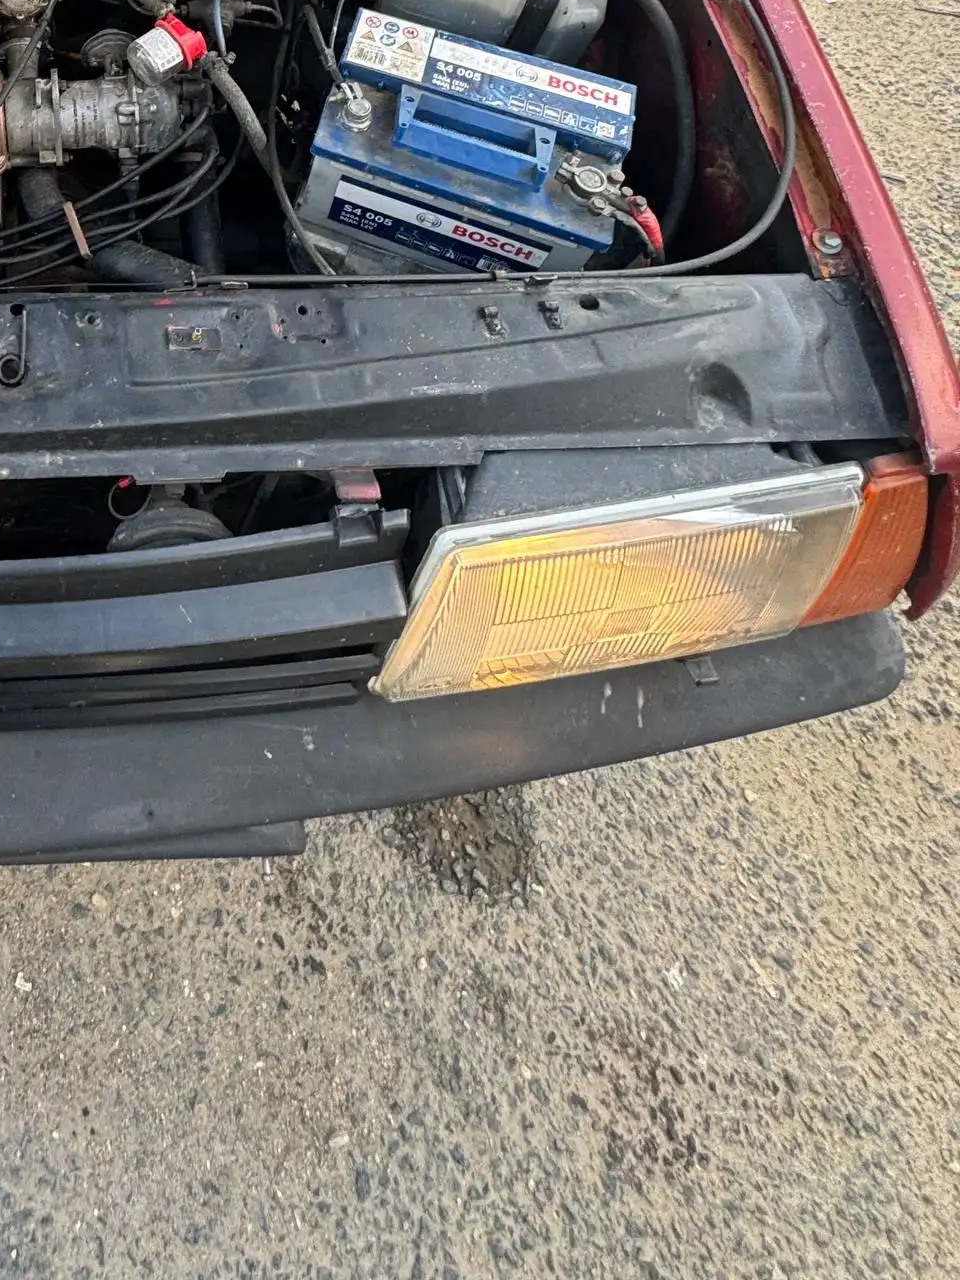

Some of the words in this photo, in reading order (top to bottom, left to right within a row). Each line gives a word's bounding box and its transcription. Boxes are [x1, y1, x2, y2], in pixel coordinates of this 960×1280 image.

[436, 61, 454, 74] S4
[457, 68, 482, 81] 005
[547, 74, 618, 106] BOSCH
[343, 204, 362, 216] S4
[365, 212, 393, 226] 005
[451, 224, 533, 260] BOSCH
